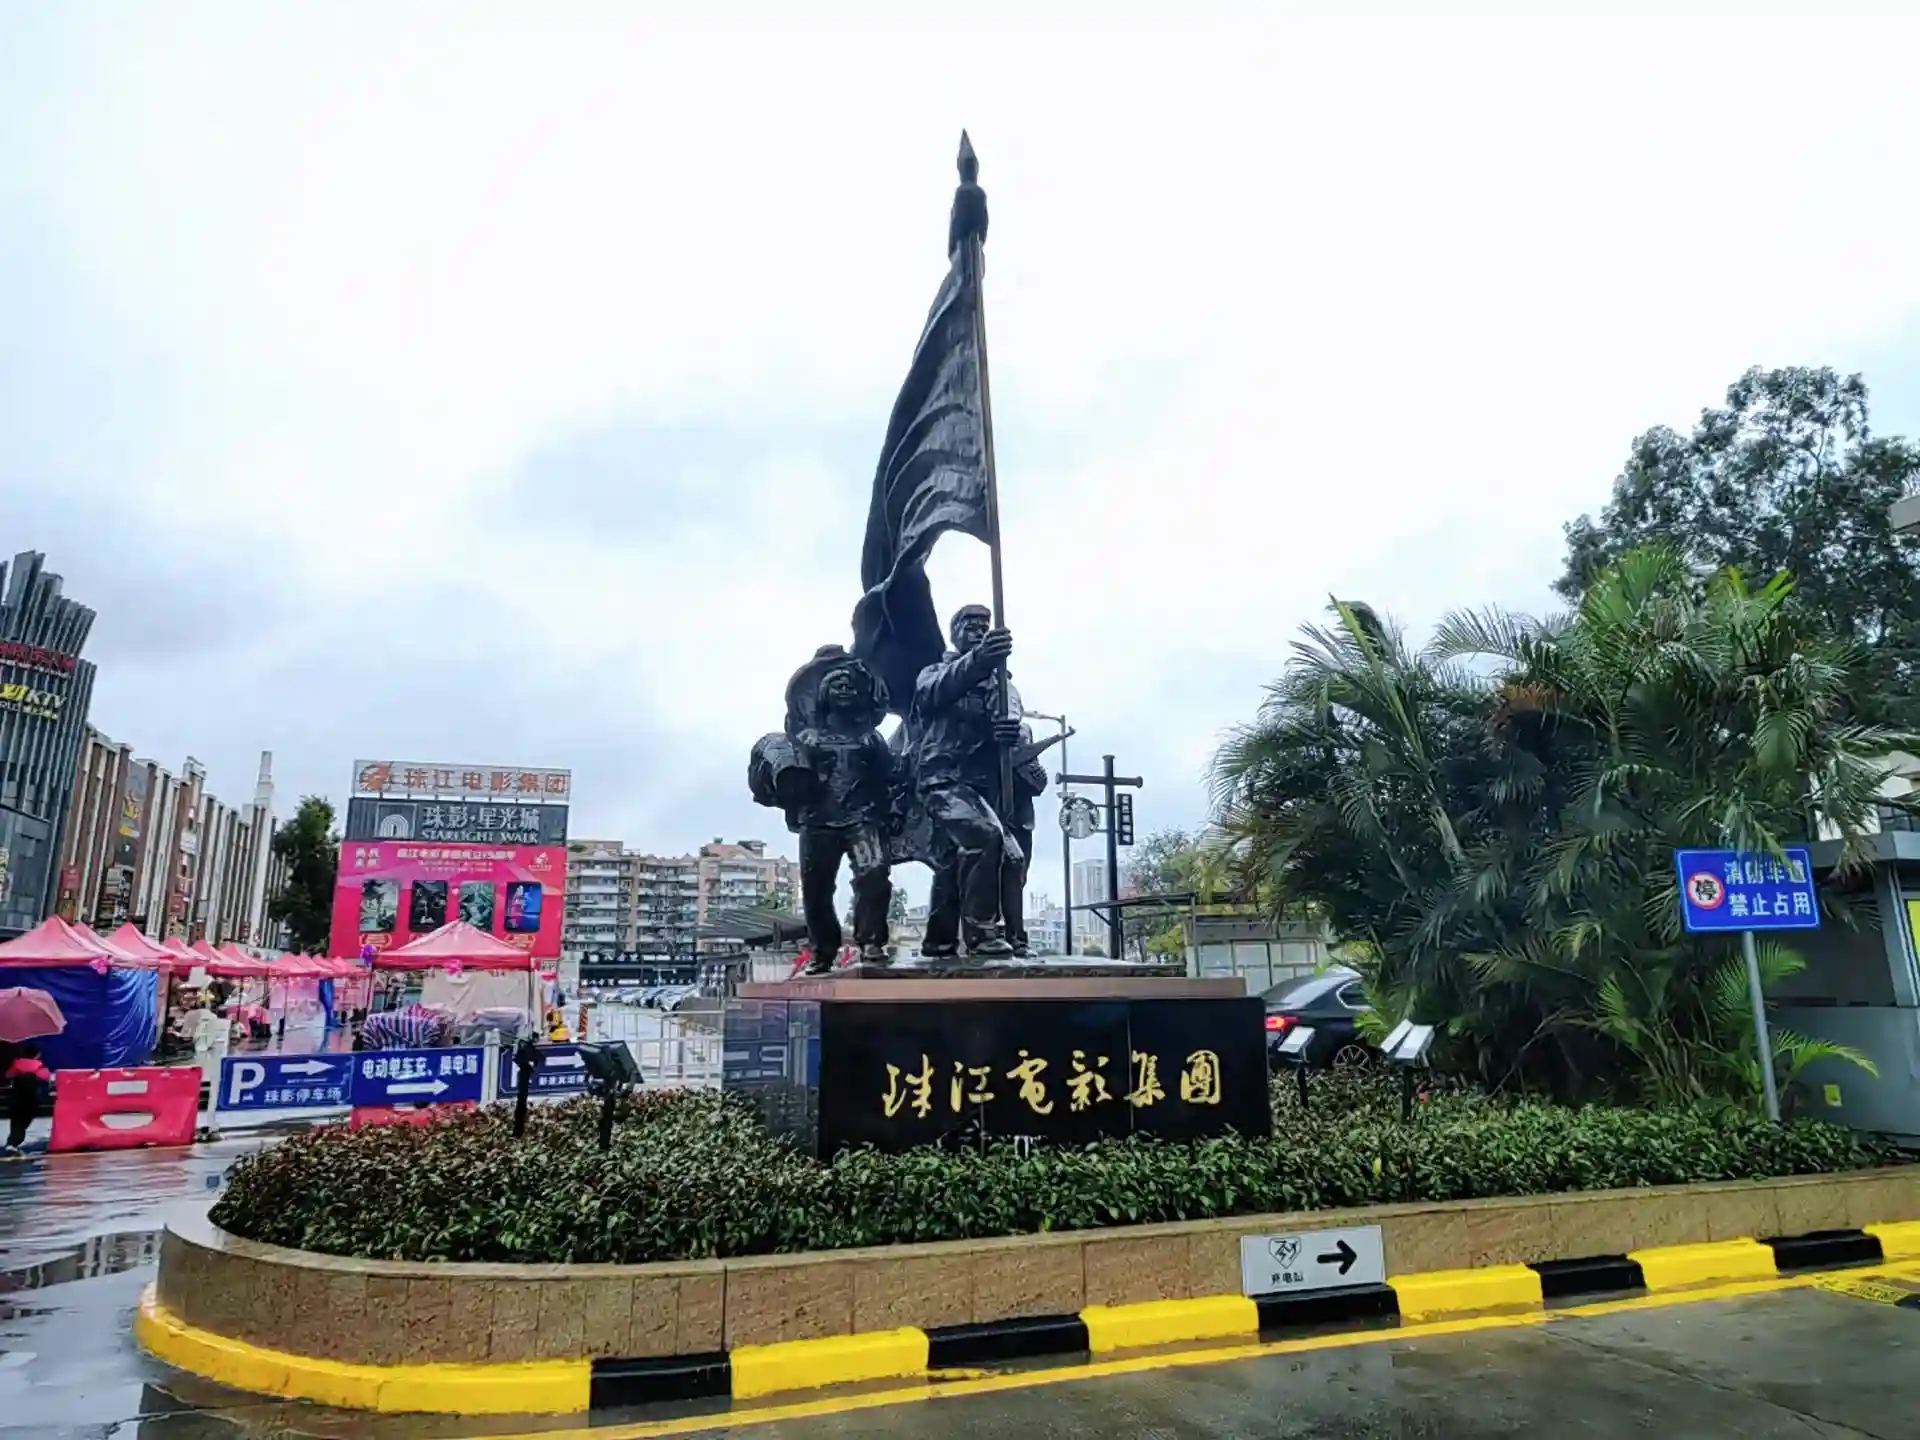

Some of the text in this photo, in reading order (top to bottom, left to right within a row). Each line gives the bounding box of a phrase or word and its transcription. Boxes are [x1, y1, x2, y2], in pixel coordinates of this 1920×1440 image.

[24, 689, 68, 709] KTV
[403, 768, 568, 794] 珠江电影集团
[422, 805, 540, 831] 珠影·星光城
[421, 830, 539, 844] STARLIGHT WALK
[1728, 892, 1811, 917] 禁止占用
[229, 1062, 265, 1104] P
[264, 1086, 342, 1104] 珠影停车场
[1271, 1272, 1304, 1286] 充电站
